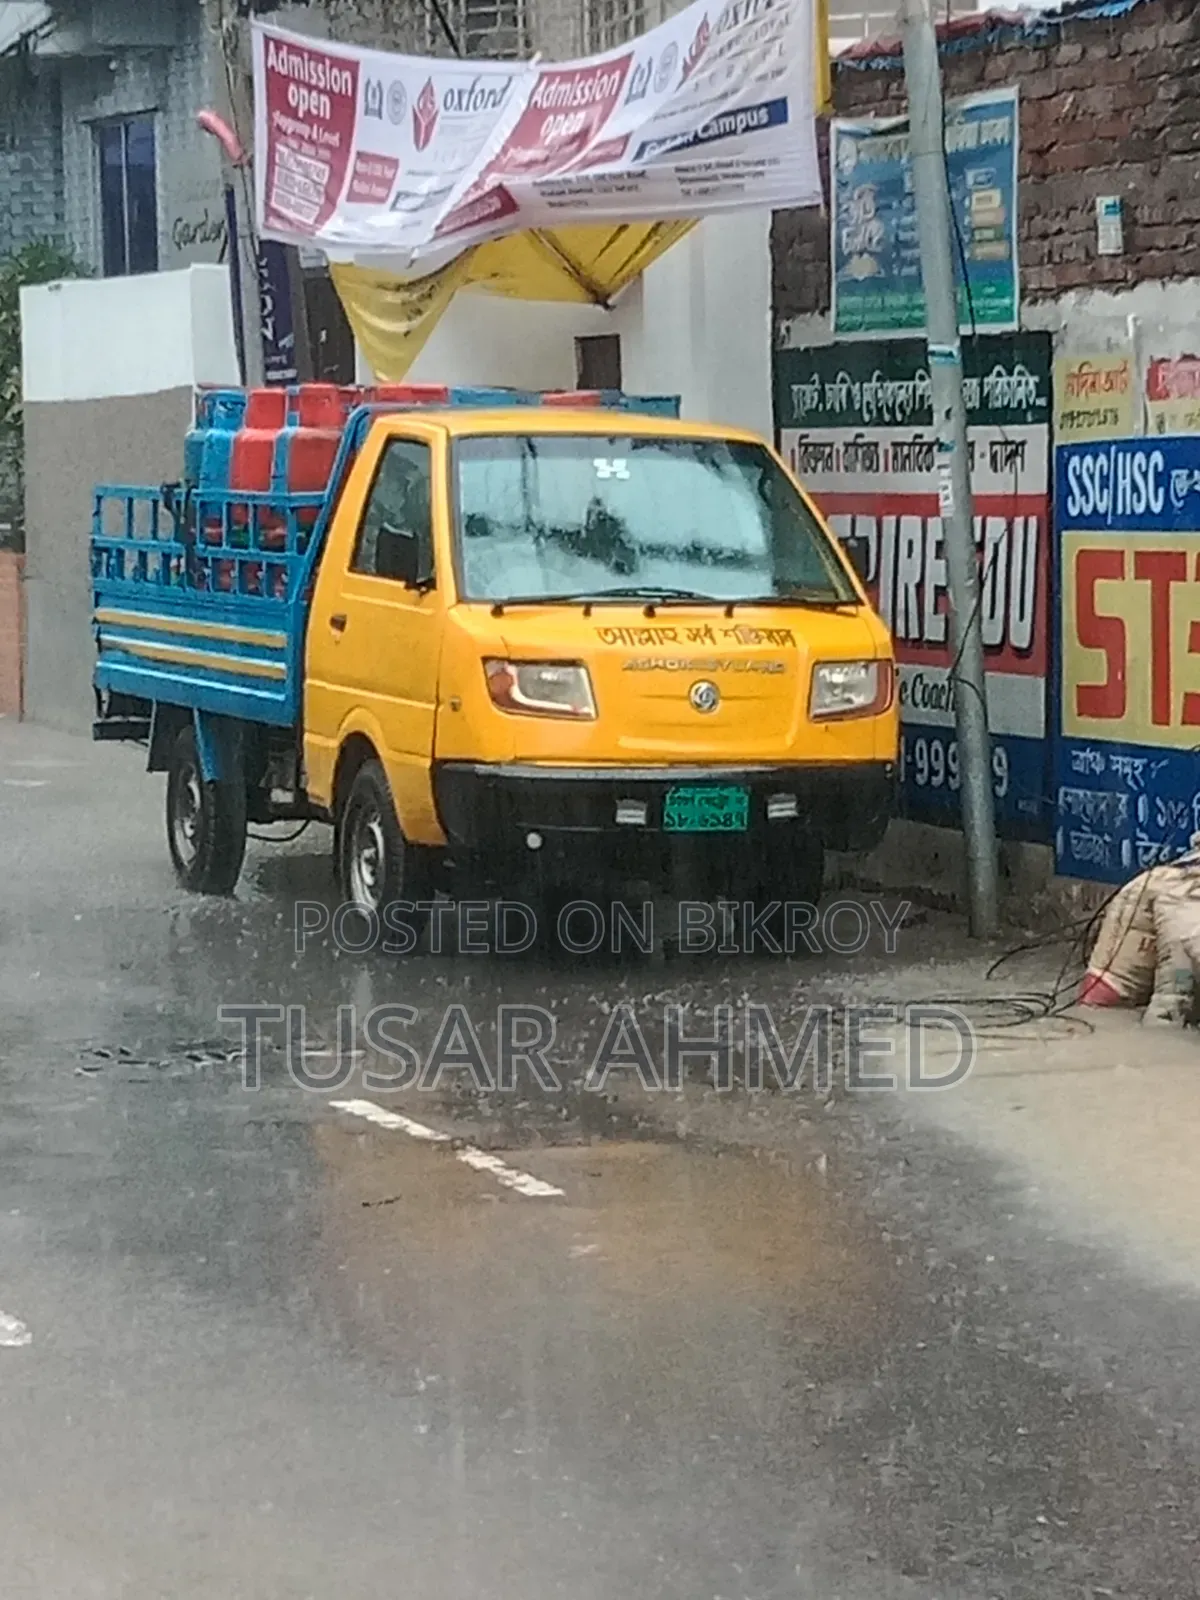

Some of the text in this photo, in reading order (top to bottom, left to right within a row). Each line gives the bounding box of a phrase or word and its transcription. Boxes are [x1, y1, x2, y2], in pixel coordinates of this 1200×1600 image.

[267, 40, 353, 97] Admission
[530, 67, 621, 109] Admission
[287, 81, 331, 120] open
[442, 75, 513, 112] oxford
[540, 111, 587, 146] open
[699, 107, 770, 139] Campus
[1066, 445, 1164, 525] SSC/HSC
[1075, 547, 1200, 728] ST
[900, 735, 1008, 798] 1-9999
